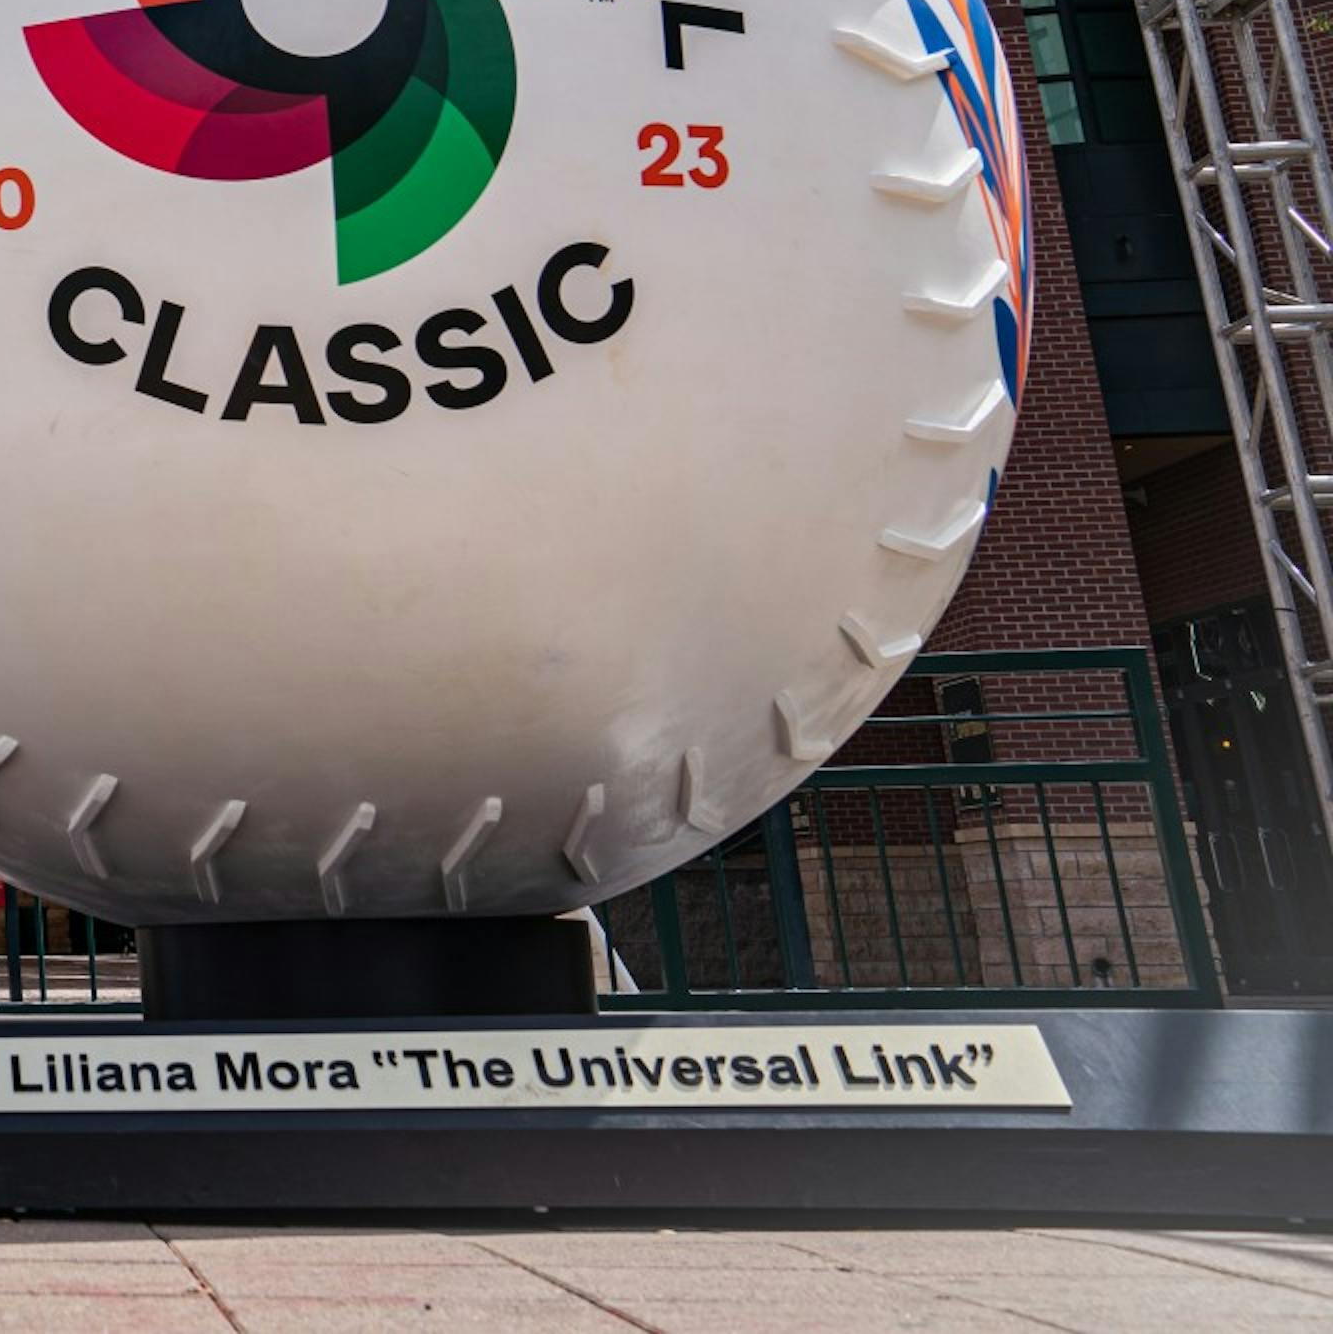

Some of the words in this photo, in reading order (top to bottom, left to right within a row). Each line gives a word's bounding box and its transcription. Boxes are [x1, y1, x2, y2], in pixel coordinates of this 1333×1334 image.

[637, 122, 730, 189] 23
[47, 241, 635, 426] CLASSIC
[10, 1053, 198, 1093] Liliana
[214, 1051, 361, 1091] Mora
[531, 1044, 820, 1088] Universal
